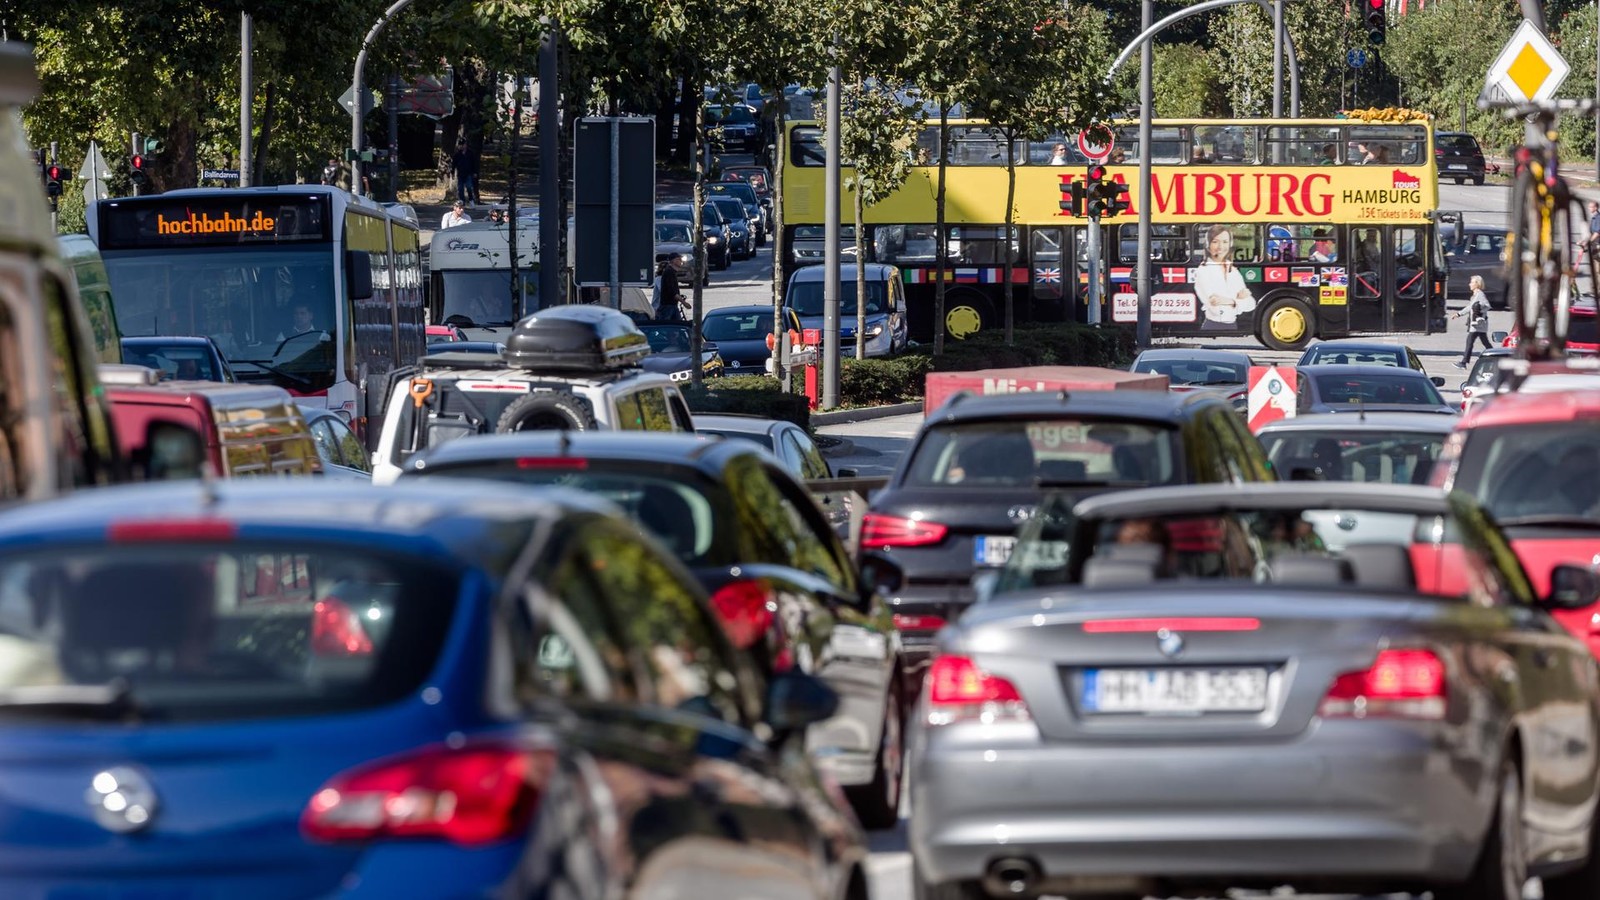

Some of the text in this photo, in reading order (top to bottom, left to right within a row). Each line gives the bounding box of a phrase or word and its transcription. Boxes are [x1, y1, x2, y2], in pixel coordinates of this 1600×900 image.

[204, 170, 239, 179] Ballindamm
[1343, 190, 1420, 203] HAMBURG
[1377, 209, 1400, 218] Tickets
[1409, 209, 1421, 218] Bus
[158, 210, 274, 234] hochbahn.de
[1117, 299, 1130, 307] Tel.
[1165, 299, 1174, 307] 82
